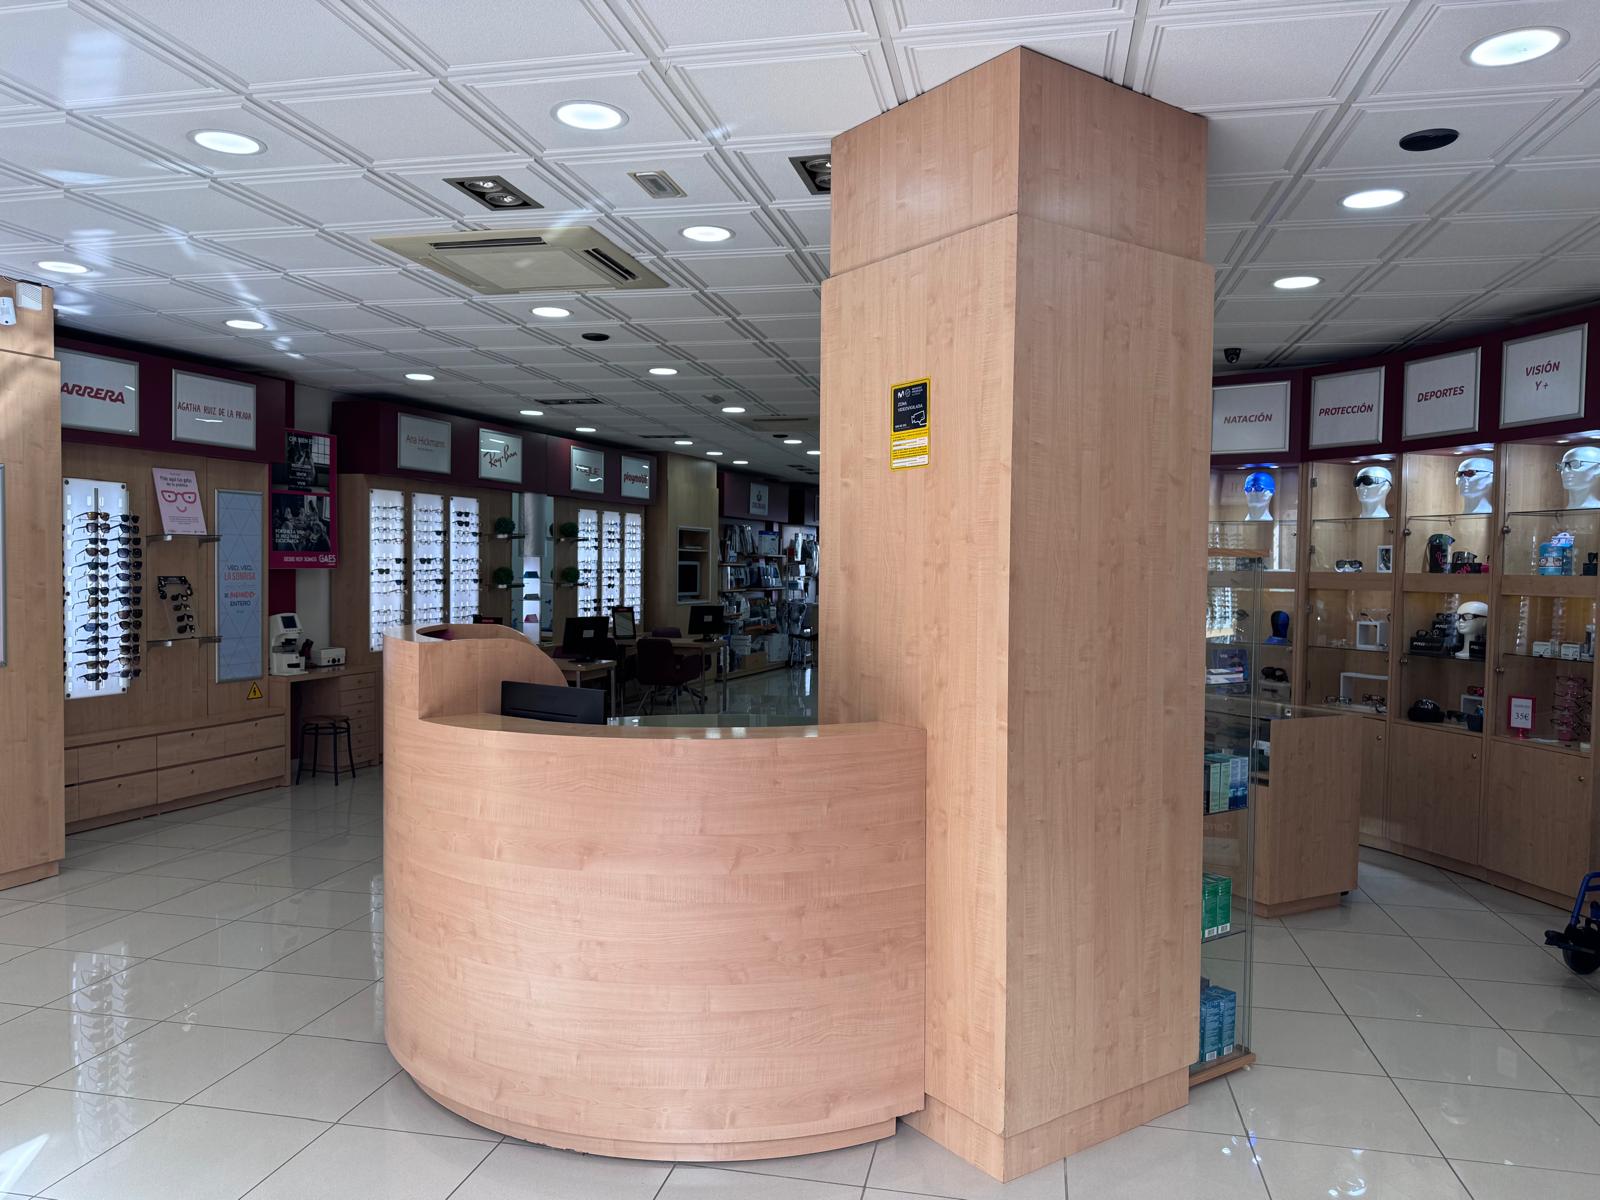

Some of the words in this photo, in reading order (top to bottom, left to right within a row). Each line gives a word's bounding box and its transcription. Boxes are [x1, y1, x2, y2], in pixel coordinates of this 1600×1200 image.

[1525, 360, 1561, 377] VISIÓN
[61, 382, 125, 404] ARRERA
[1416, 385, 1465, 403] DEPORTES
[177, 402, 201, 413] AGATHA
[203, 405, 217, 416] RUIZ
[218, 407, 225, 417] DE
[226, 409, 234, 418] LA
[235, 410, 252, 420] PRADA
[1223, 412, 1273, 425] NATACIÓN
[1318, 403, 1374, 418] PROTECCIÓN
[318, 554, 337, 563] GAES
[1513, 712, 1530, 721] 35€
